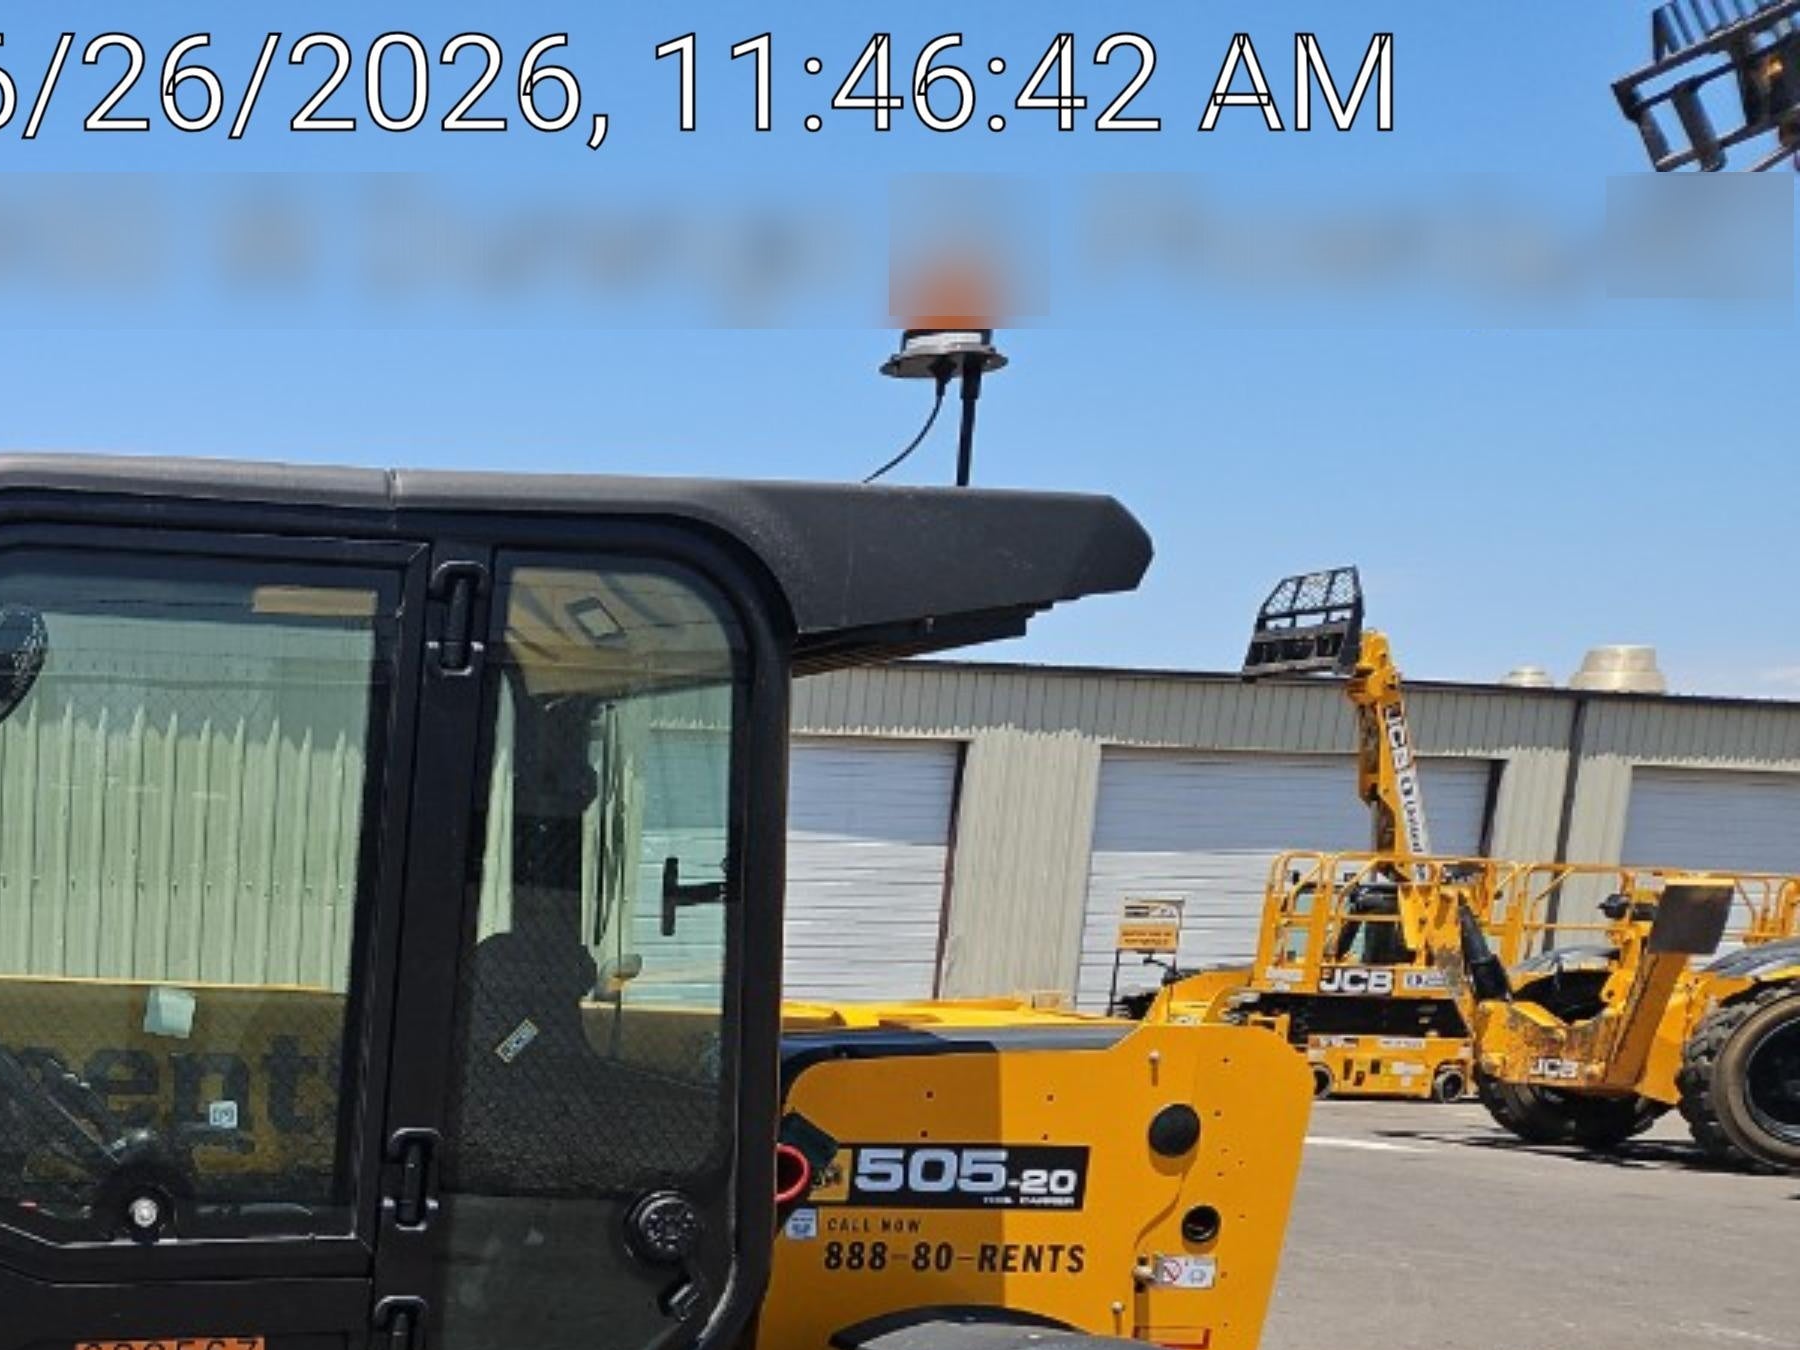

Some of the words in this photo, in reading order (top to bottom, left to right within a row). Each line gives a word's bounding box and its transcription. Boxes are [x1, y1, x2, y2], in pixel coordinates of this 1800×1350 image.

[1319, 968, 1393, 993] JCB
[826, 1217, 871, 1232] CALL
[881, 1217, 922, 1232] NOW
[823, 1241, 1086, 1273] 888-80-RENTS
